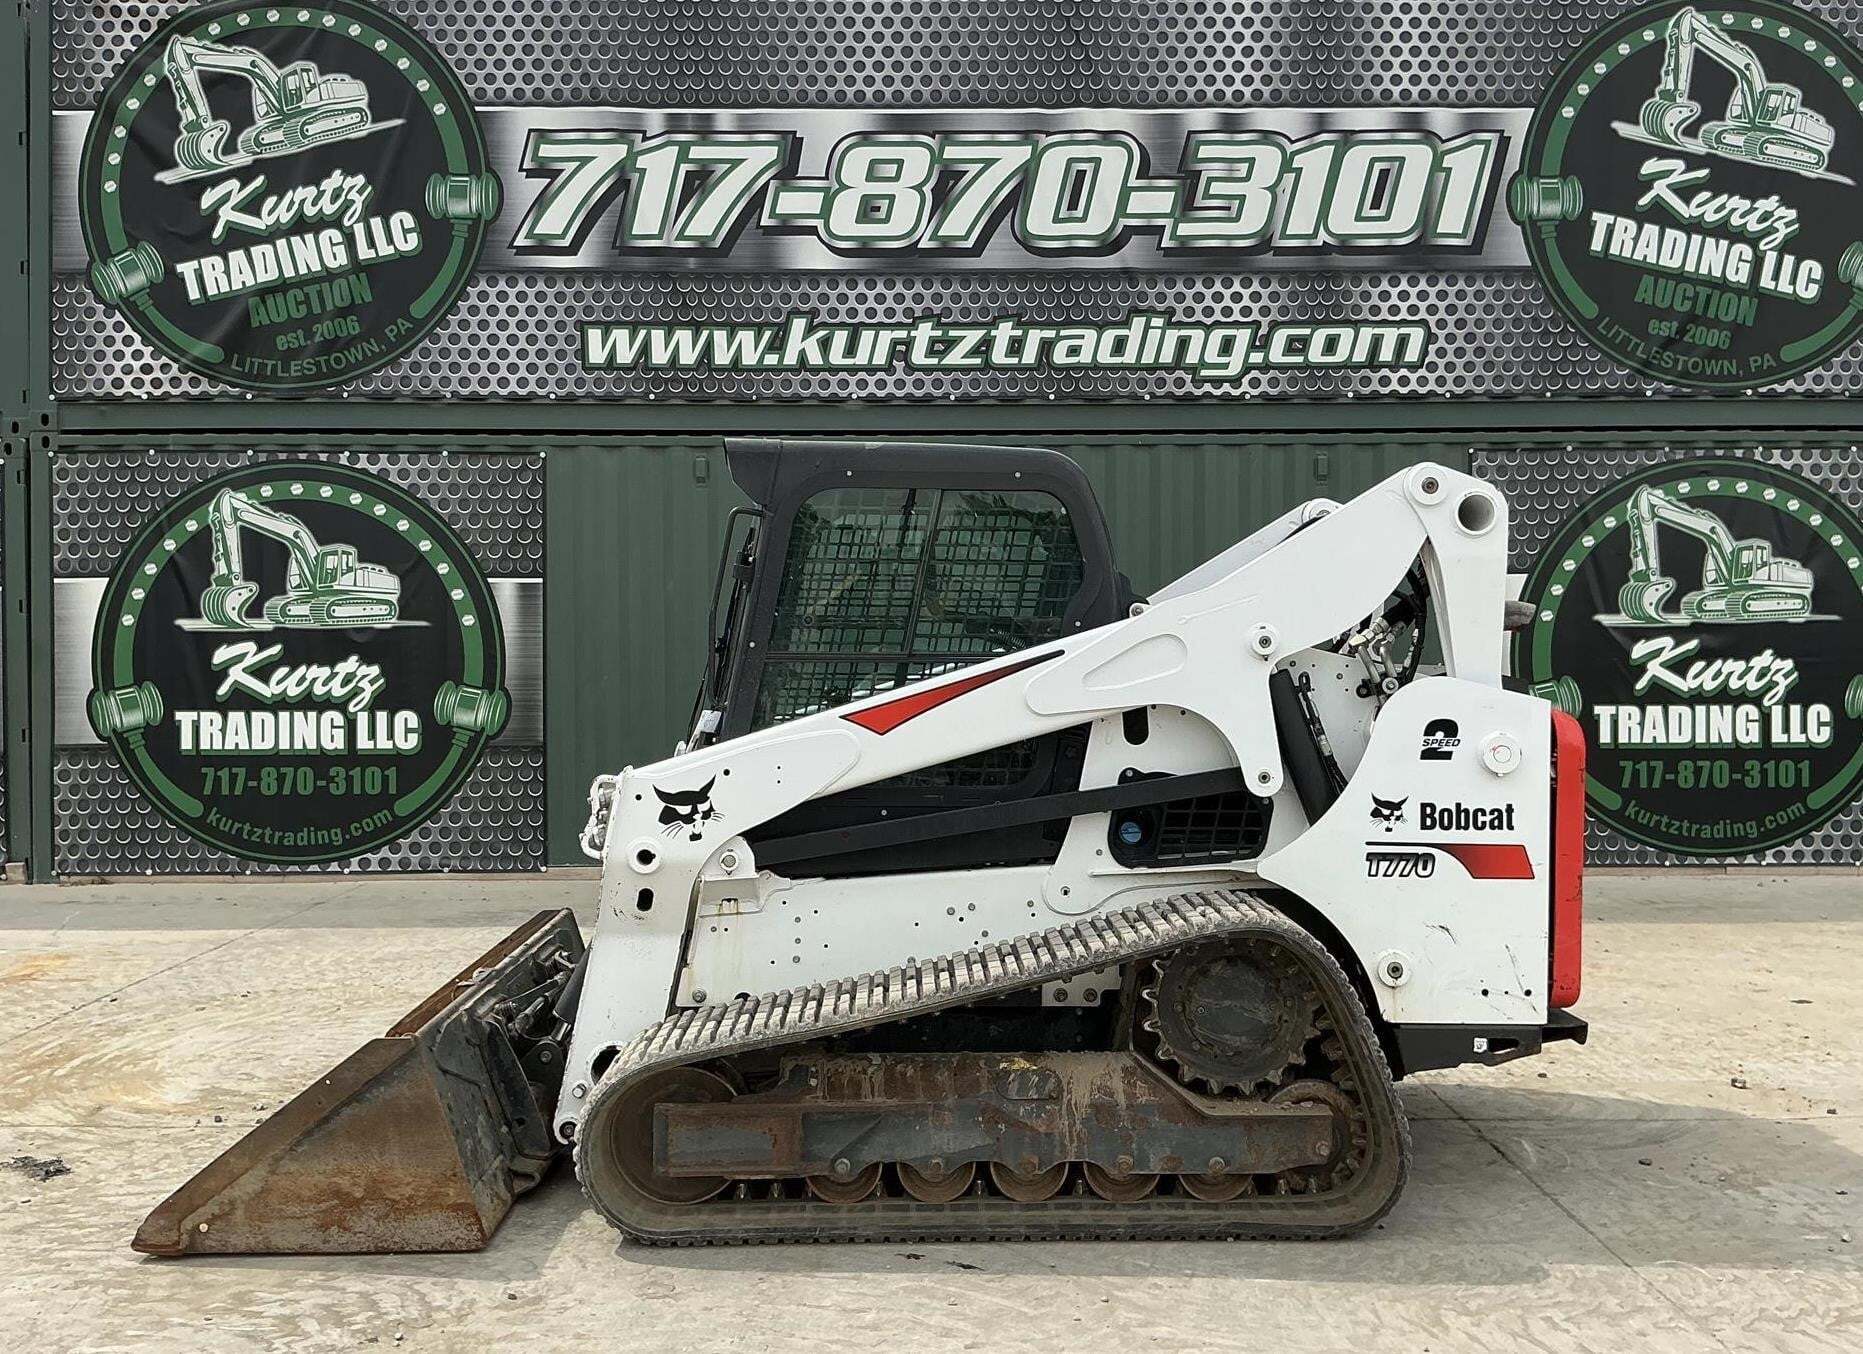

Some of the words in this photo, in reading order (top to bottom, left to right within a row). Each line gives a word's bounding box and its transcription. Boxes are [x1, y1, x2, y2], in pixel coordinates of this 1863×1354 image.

[201, 169, 372, 239] Kurtz
[510, 130, 1508, 253] 717-870-3101
[1637, 157, 1799, 250] Kurtz
[176, 228, 346, 301] TRADING
[353, 211, 420, 262] LLC
[1590, 211, 1754, 284] TRADING
[1759, 250, 1824, 300] LLC
[249, 273, 373, 328] AUCTION
[1634, 274, 1759, 327] AUCTION
[230, 338, 387, 377] LITTLESTOWN,
[386, 318, 414, 343] PA
[276, 326, 307, 350] est.
[312, 315, 360, 343] 2006
[583, 313, 1429, 381] www.kurtztrading.com
[1597, 317, 1743, 377] LITTLESTOWN,
[1749, 355, 1777, 373] PA
[1648, 319, 1680, 340] est.
[1684, 325, 1732, 350] 2006
[212, 641, 384, 713] Kurtz
[1630, 636, 1799, 707] Kurtz
[175, 710, 347, 752] TRADING
[354, 710, 421, 751] LLC
[1420, 718, 1459, 760] 2
[1422, 736, 1461, 748] SPEED
[1594, 704, 1761, 745] TRADING
[1769, 704, 1834, 744] LLC
[201, 766, 397, 796] 717-870-3101
[1619, 759, 1811, 789] 717-870-3101
[207, 807, 393, 847] kurtztrading.com
[1420, 802, 1515, 831] Bobcat
[1624, 798, 1806, 840] kurtztrading.com
[1366, 853, 1436, 877] T770
